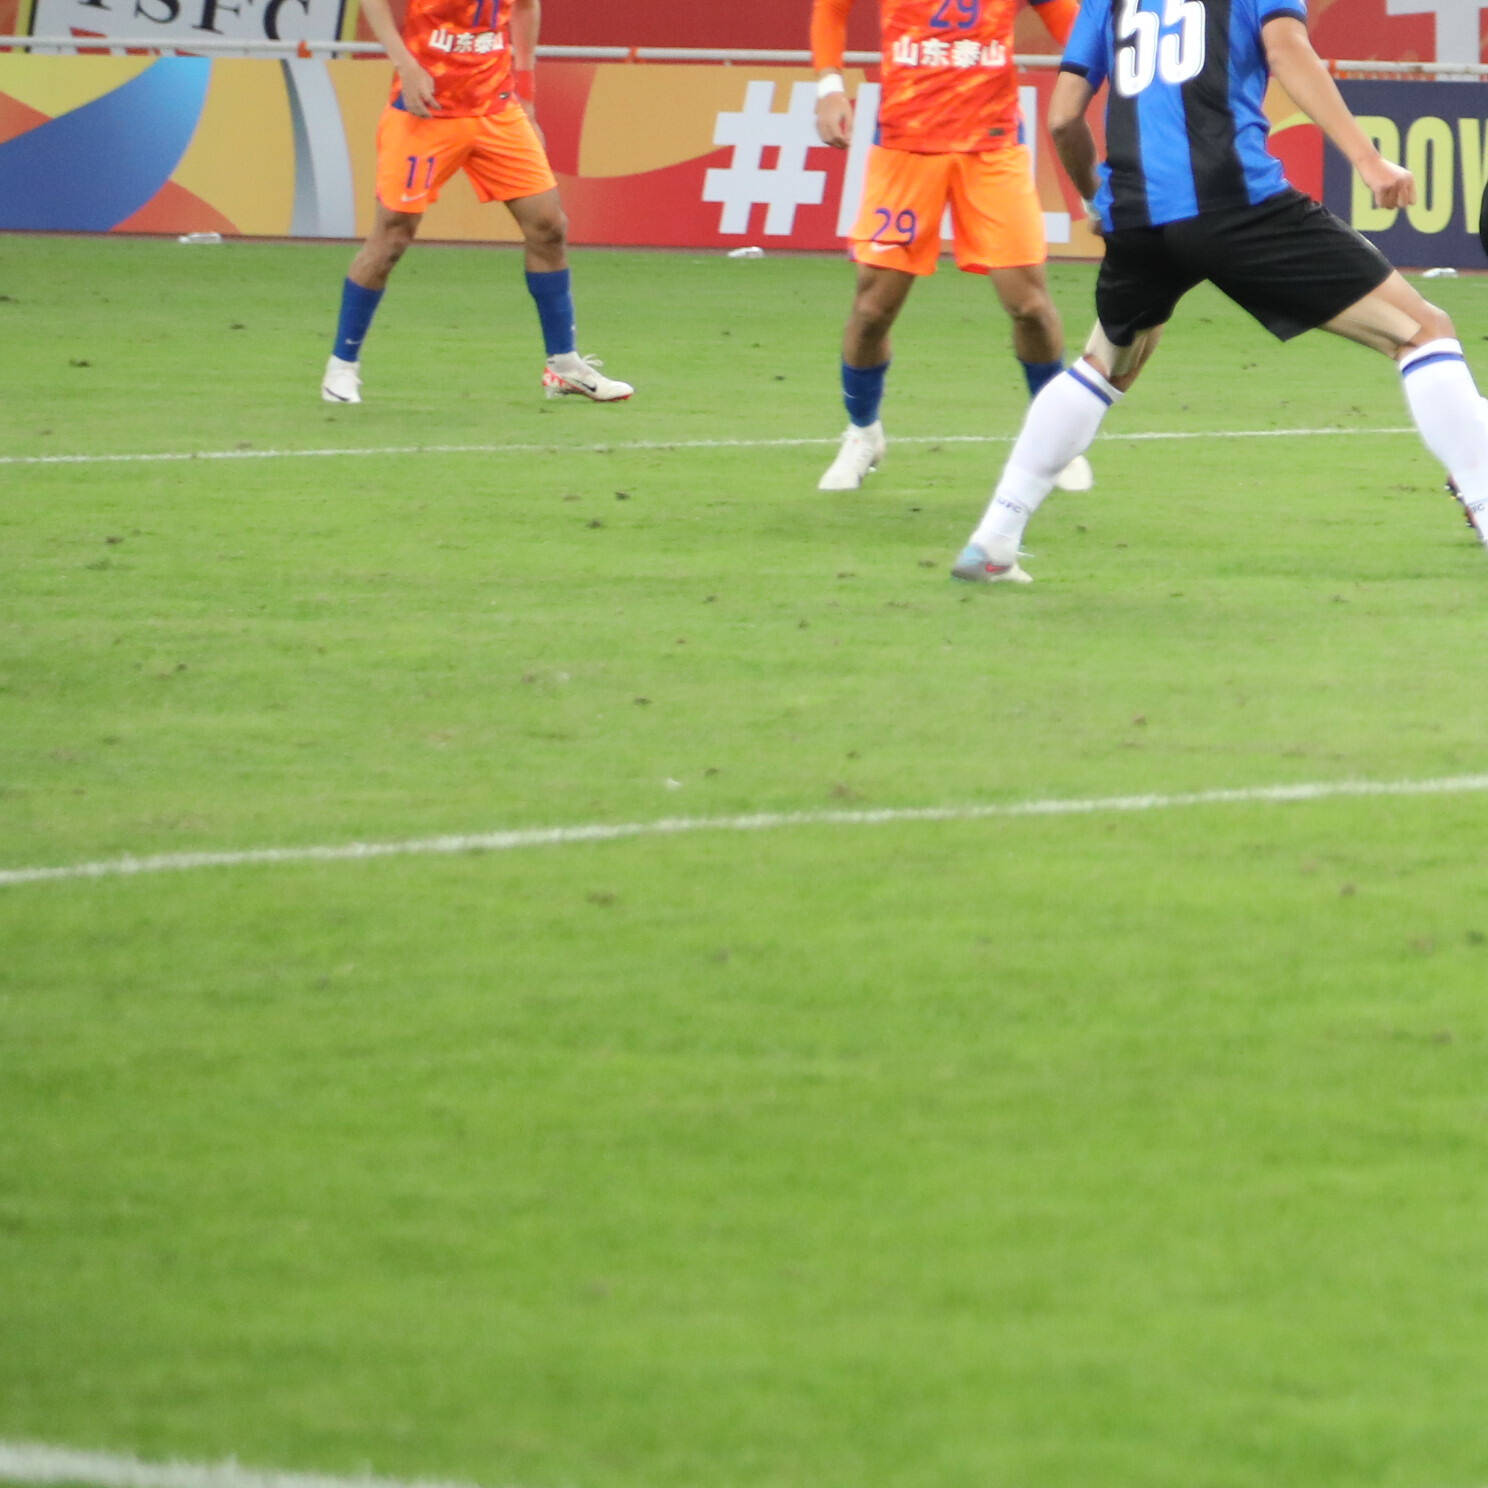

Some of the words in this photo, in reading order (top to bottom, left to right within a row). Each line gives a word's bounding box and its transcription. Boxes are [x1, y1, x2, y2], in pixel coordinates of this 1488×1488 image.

[892, 36, 1007, 69] 山东泰山
[406, 155, 436, 189] 11
[871, 207, 917, 246] 29
